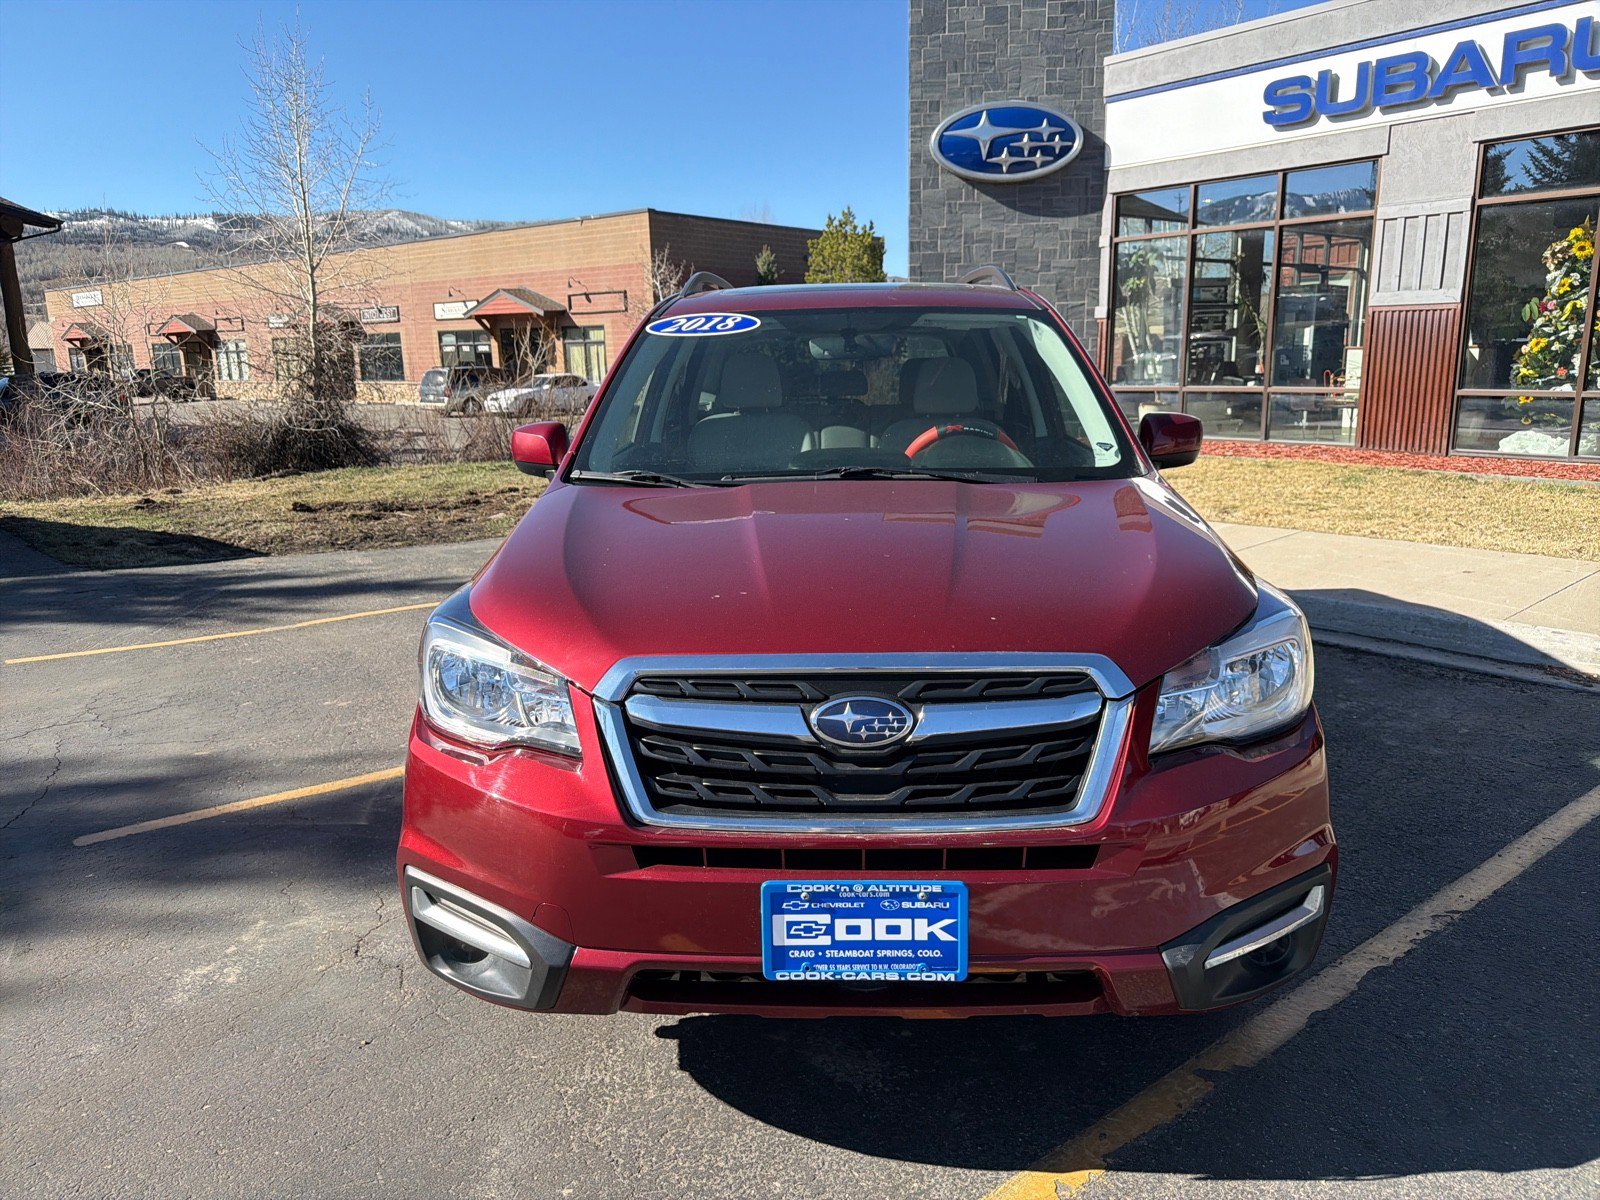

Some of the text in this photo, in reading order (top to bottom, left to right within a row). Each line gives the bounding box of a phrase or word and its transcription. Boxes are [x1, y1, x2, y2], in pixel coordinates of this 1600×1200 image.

[661, 316, 742, 333] 2018
[867, 884, 942, 893] ALTITUDE
[901, 901, 950, 909] SUBARU
[772, 914, 958, 946] COOK
[788, 949, 943, 958] CRAIG STEAMBOAT SPRINGS, COLO.
[775, 971, 955, 981] COOK-CARS.COM
